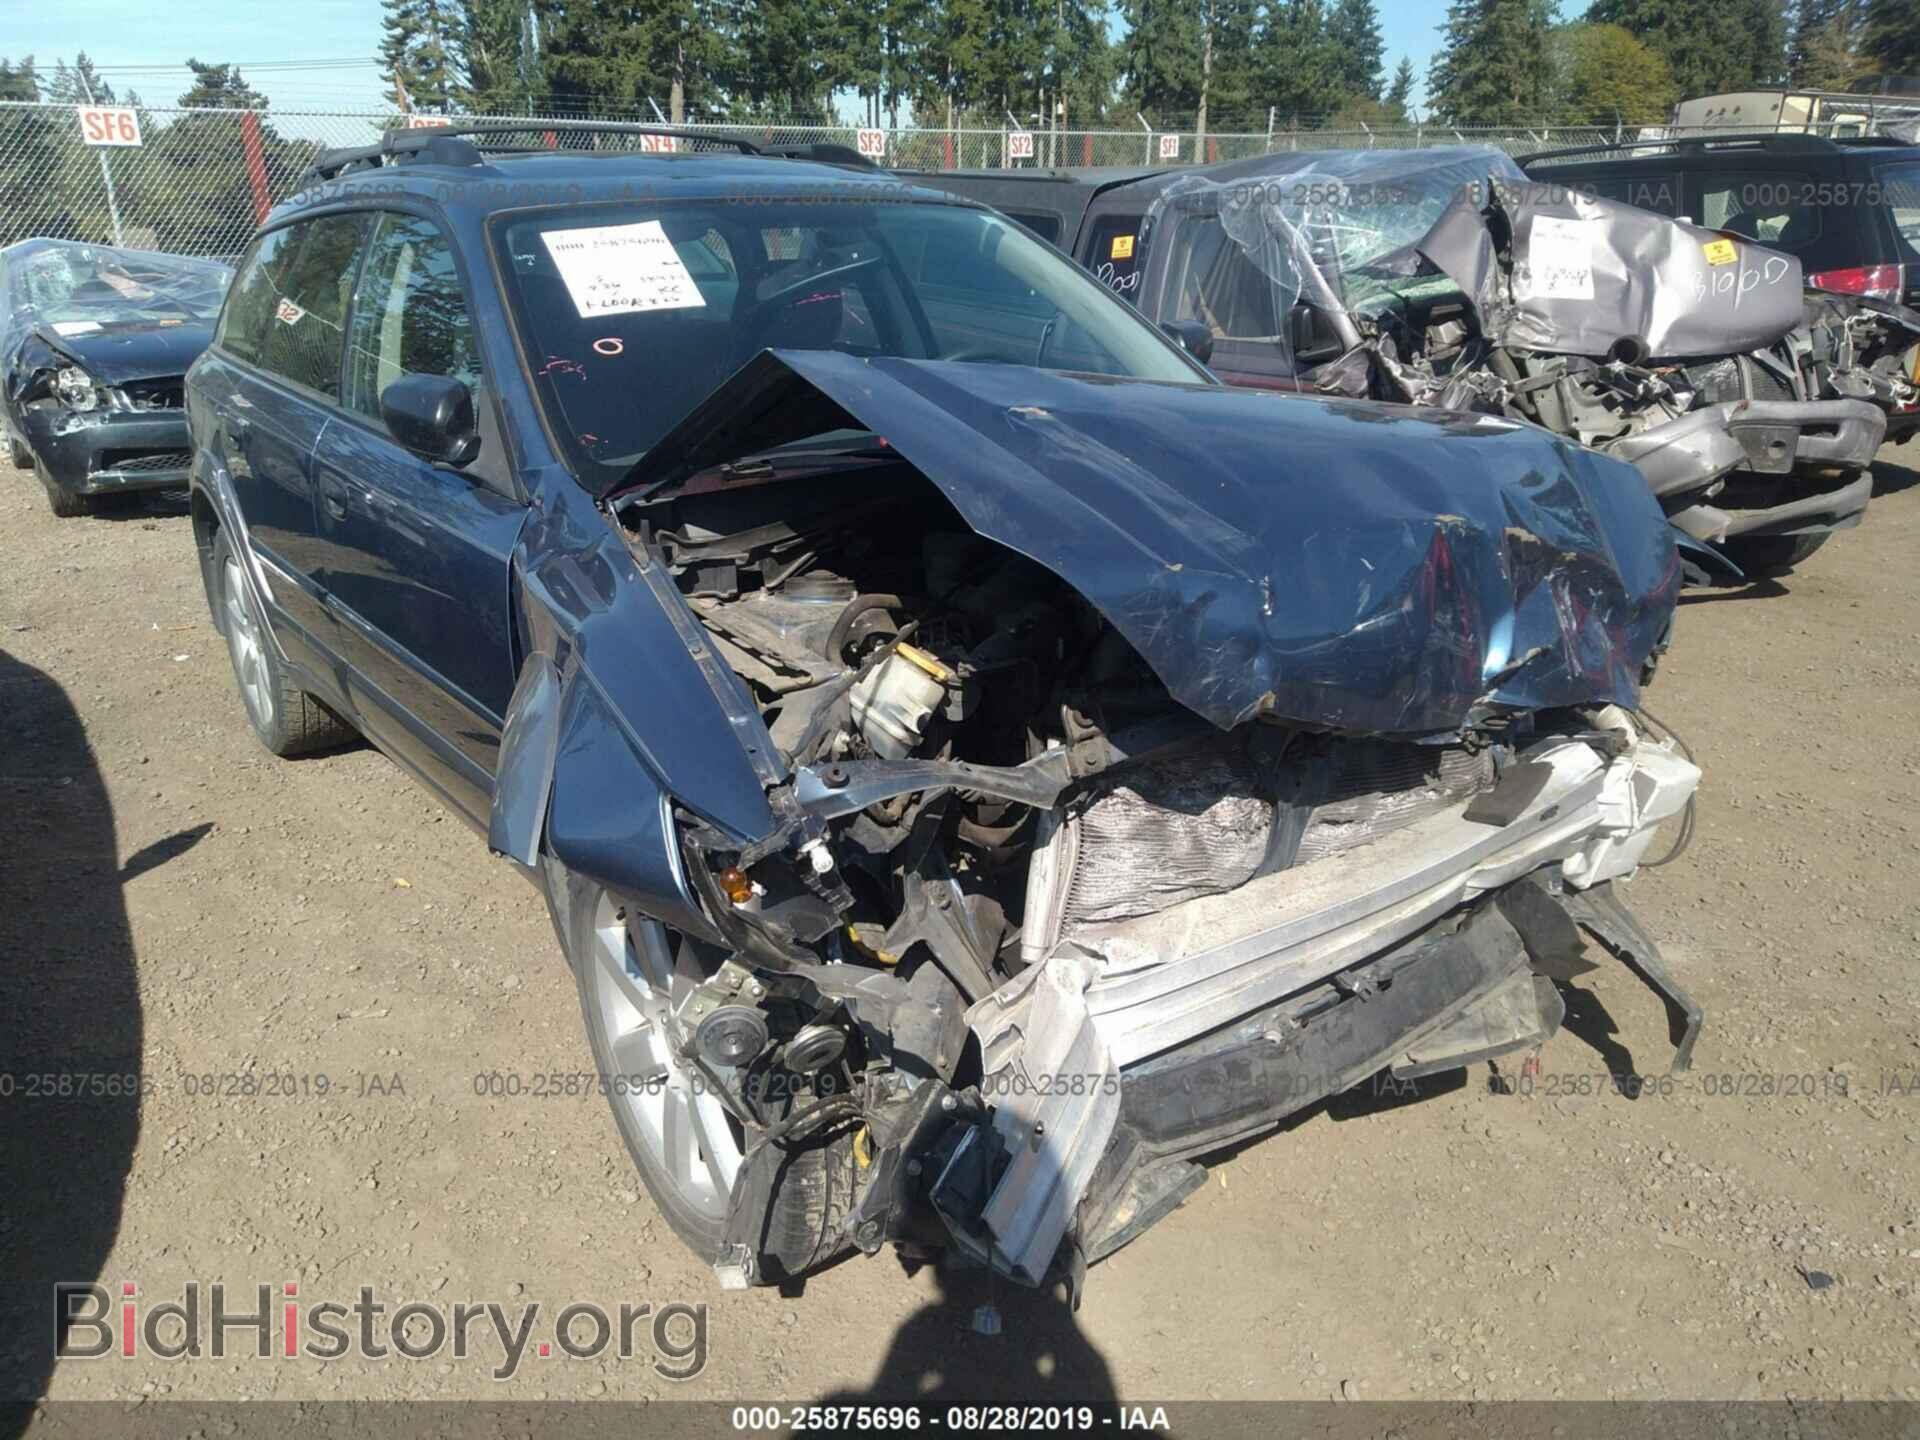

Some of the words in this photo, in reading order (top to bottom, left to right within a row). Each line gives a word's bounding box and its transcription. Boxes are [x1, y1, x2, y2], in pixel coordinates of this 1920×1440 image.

[84, 111, 136, 141] SF6
[858, 132, 884, 154] SF3
[1010, 135, 1033, 155] SF2
[1161, 136, 1178, 156] SF1
